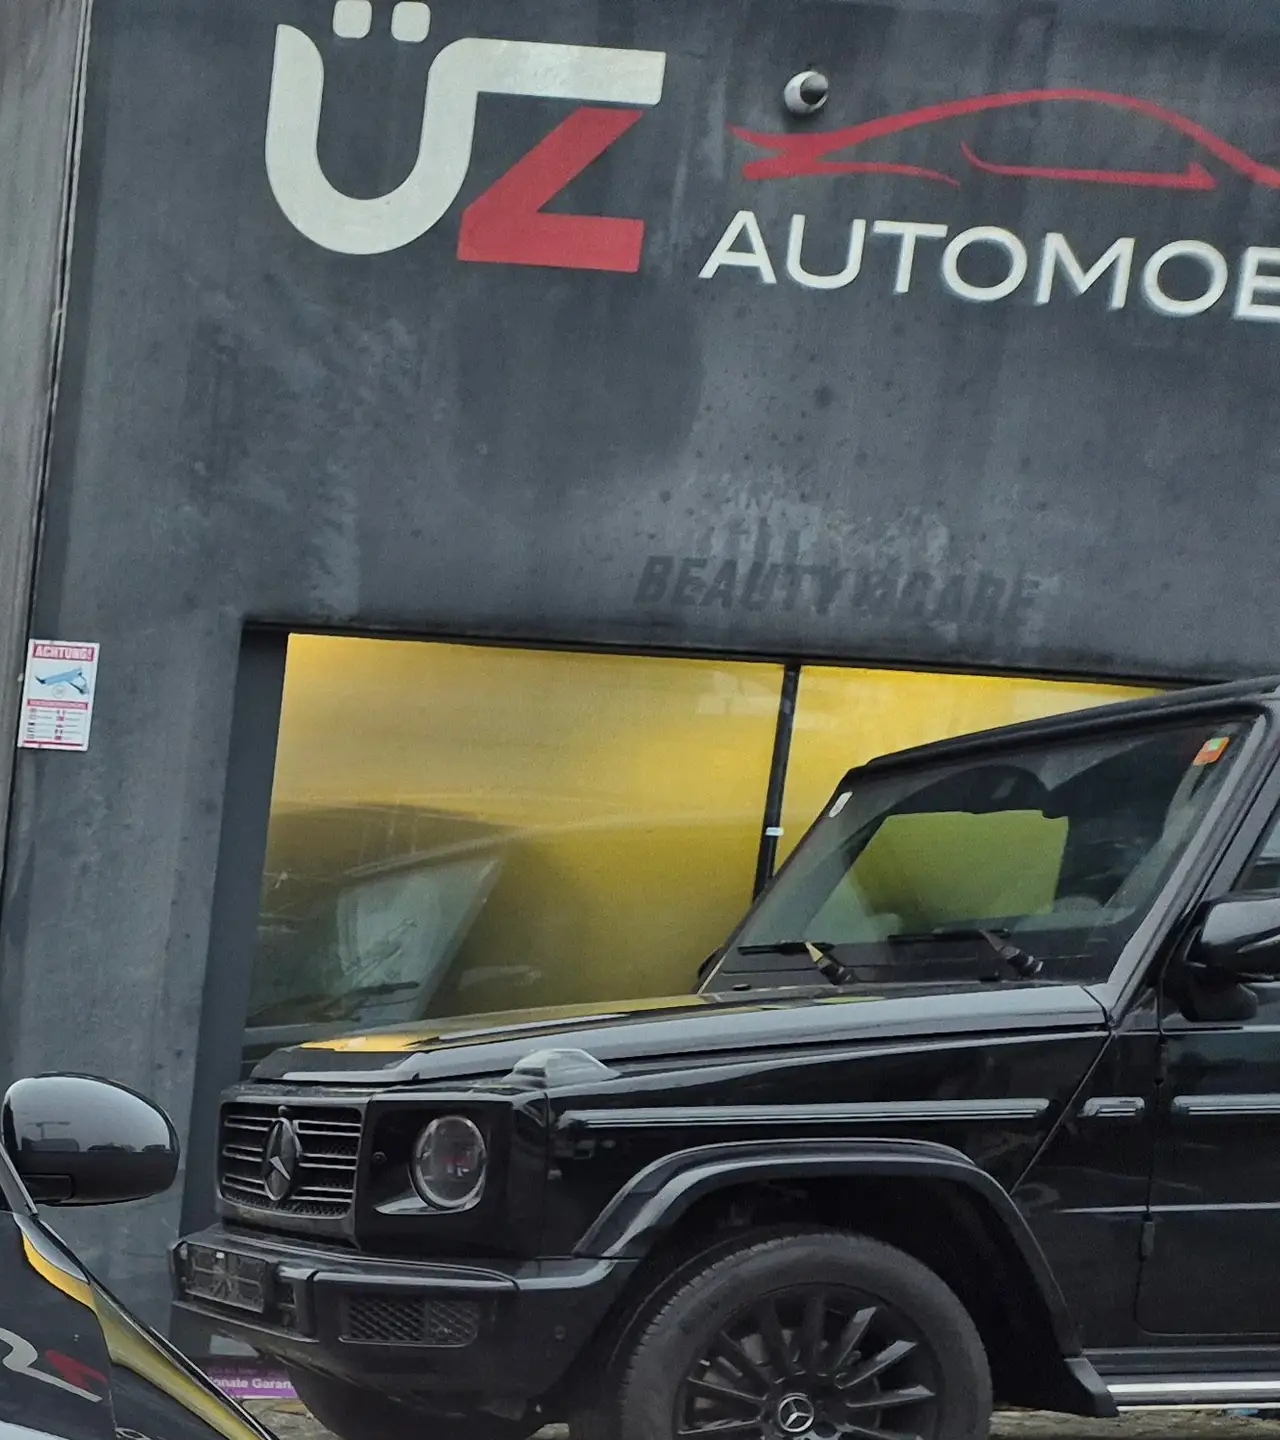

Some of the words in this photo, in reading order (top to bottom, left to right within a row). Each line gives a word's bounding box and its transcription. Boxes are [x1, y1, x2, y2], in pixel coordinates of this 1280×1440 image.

[633, 555, 845, 615] BEAUTY
[34, 645, 93, 661] ACHTUNG!
[210, 1377, 249, 1388] onate
